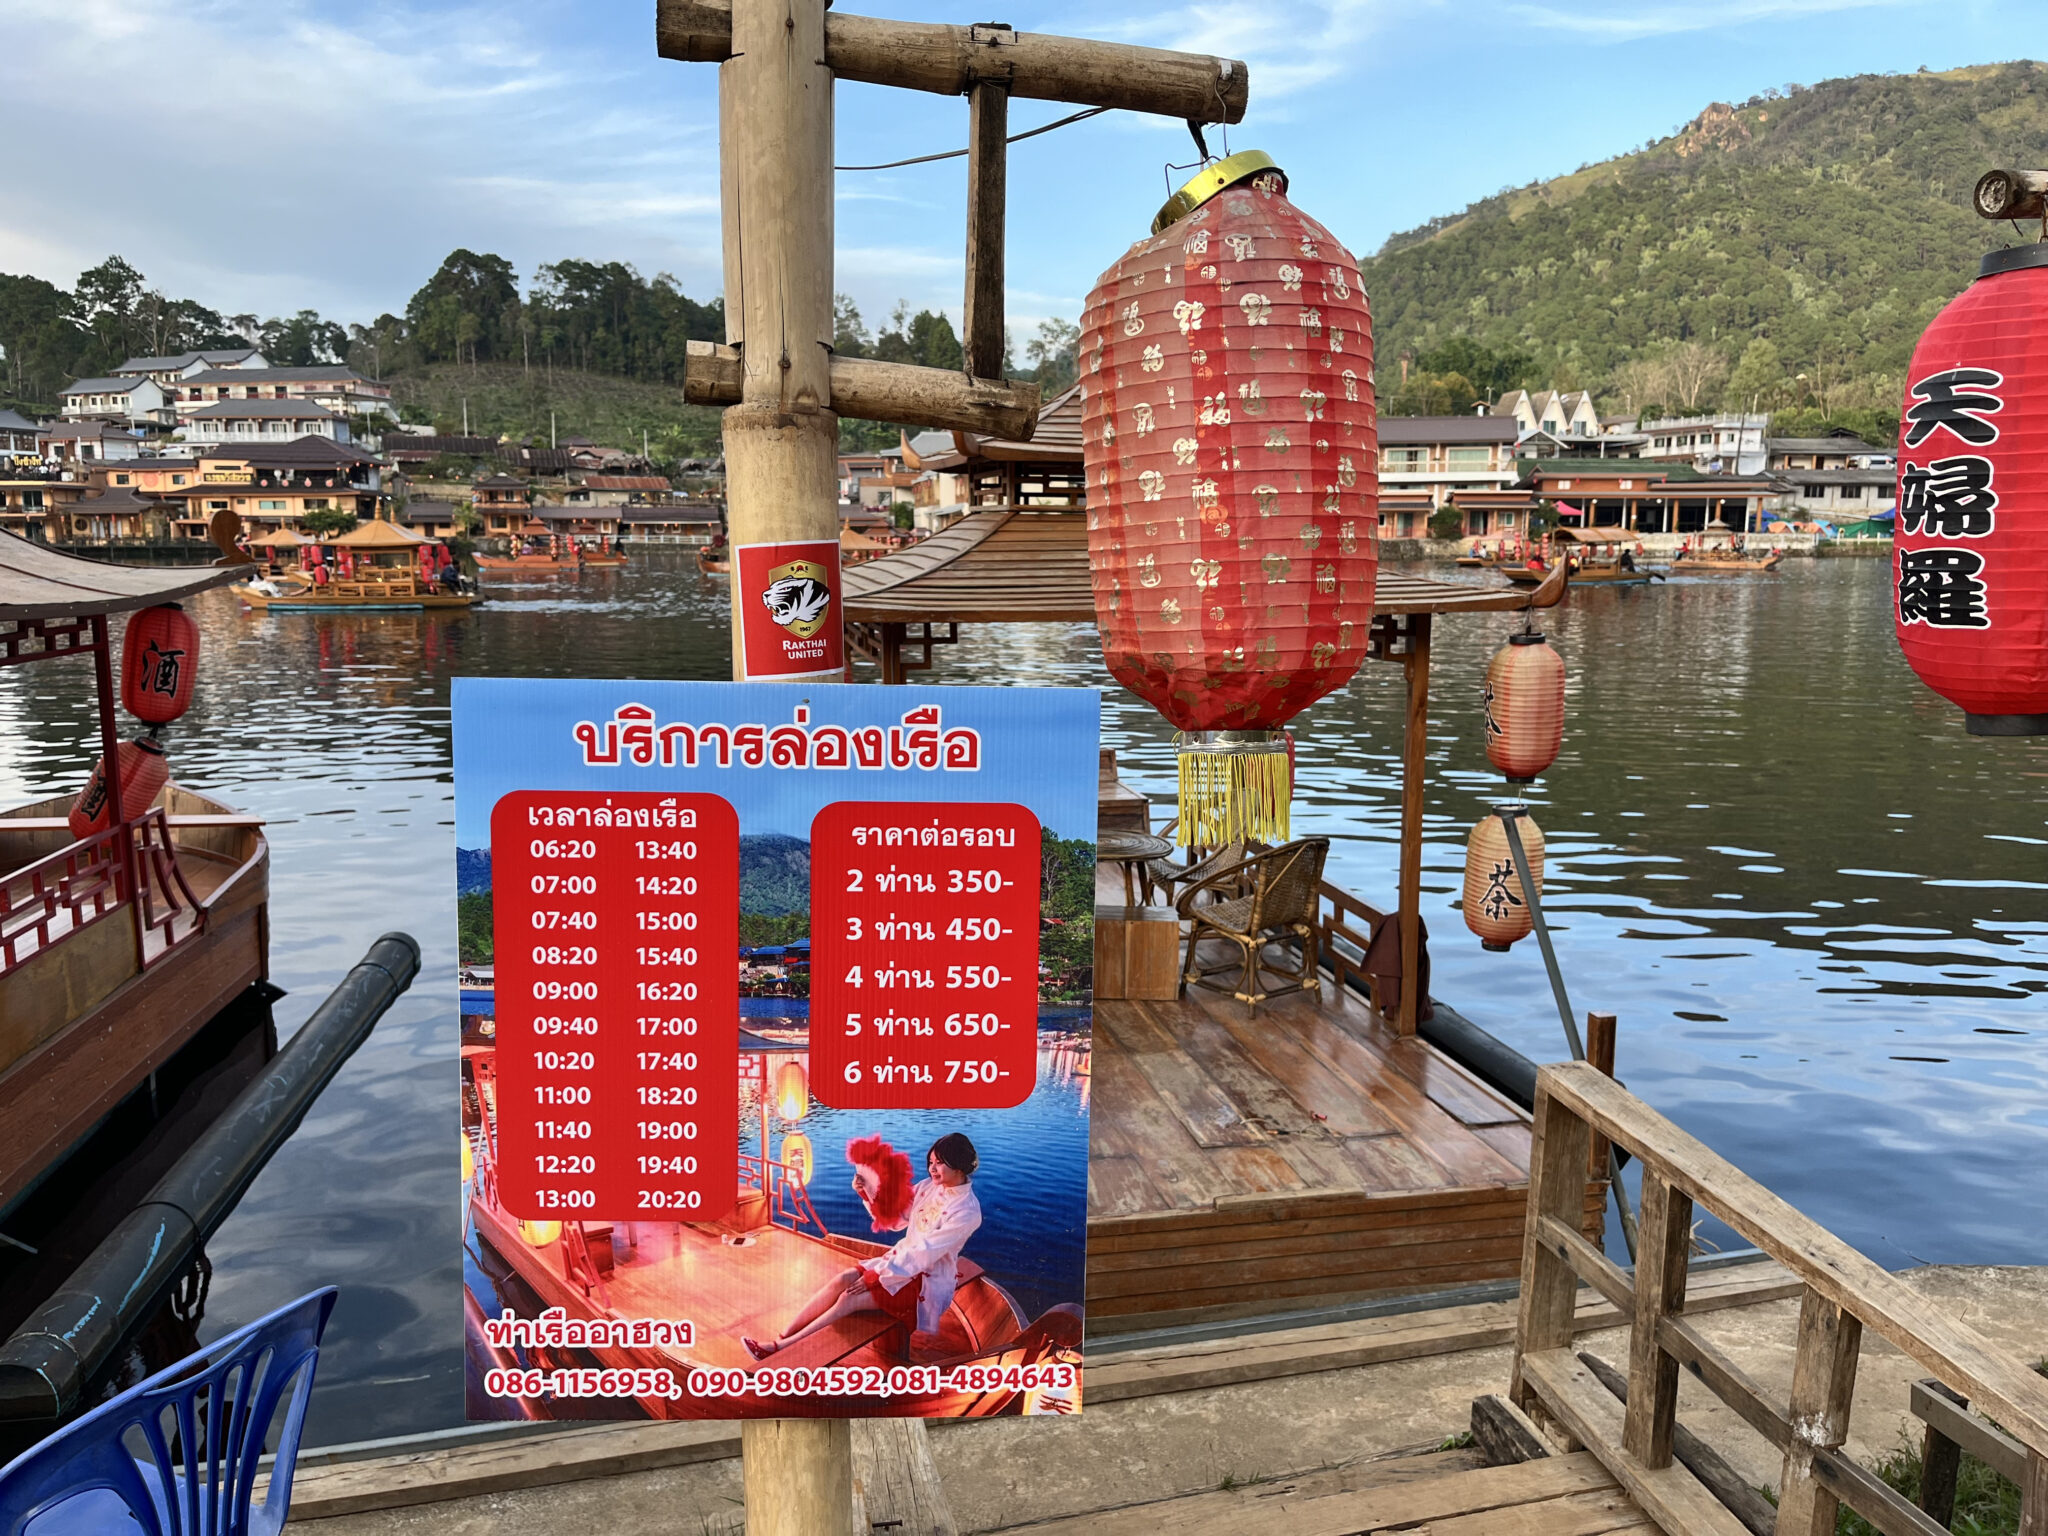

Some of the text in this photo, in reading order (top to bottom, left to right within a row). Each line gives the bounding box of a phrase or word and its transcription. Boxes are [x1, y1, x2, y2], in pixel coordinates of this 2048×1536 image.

[1899, 367, 2004, 630] 天婦羅
[782, 639, 827, 650] RAKTHAI
[788, 649, 824, 660] UNITED
[140, 640, 185, 699] 酒
[573, 702, 982, 772] บริการล่องเรือ
[528, 797, 698, 829] เวลาล่องเรือ
[851, 818, 1016, 848] ราคาต่อรอบ
[531, 839, 597, 859] 06:20
[636, 840, 697, 860] 13:40
[531, 875, 597, 895] 07:00
[636, 876, 698, 896] 14:20
[846, 864, 1015, 894] 2 ท่าน 350-
[1478, 858, 1522, 922] 茶
[532, 910, 598, 930] 07:40
[636, 911, 698, 931] 15:00
[845, 912, 1014, 941] 3 ท่าน 450-
[533, 946, 598, 965] 08:20
[637, 947, 698, 966] 15:40
[844, 960, 1013, 989] 4 ท่าน 550-
[533, 981, 598, 1001] 09:00
[637, 982, 698, 1001] 16:20
[534, 1016, 599, 1036] 09:40
[637, 1017, 698, 1036] 17:00
[845, 1008, 1012, 1037] 5 ท่าน 650-
[534, 1051, 595, 1070] 10:20
[637, 1052, 698, 1071] 17:40
[843, 1055, 1011, 1084] 6 ท่าน 750-
[535, 1086, 592, 1105] 11:00
[637, 1086, 698, 1106] 18:20
[535, 1120, 592, 1139] 11:40
[637, 1121, 698, 1140] 19:00
[536, 1155, 596, 1174] 12:20
[637, 1155, 698, 1175] 19:40
[536, 1189, 596, 1208] 13:00
[638, 1190, 702, 1209] 20:20
[484, 1307, 696, 1349] ท่าเรืออาฮวง
[484, 1367, 682, 1400] 086-1156958,
